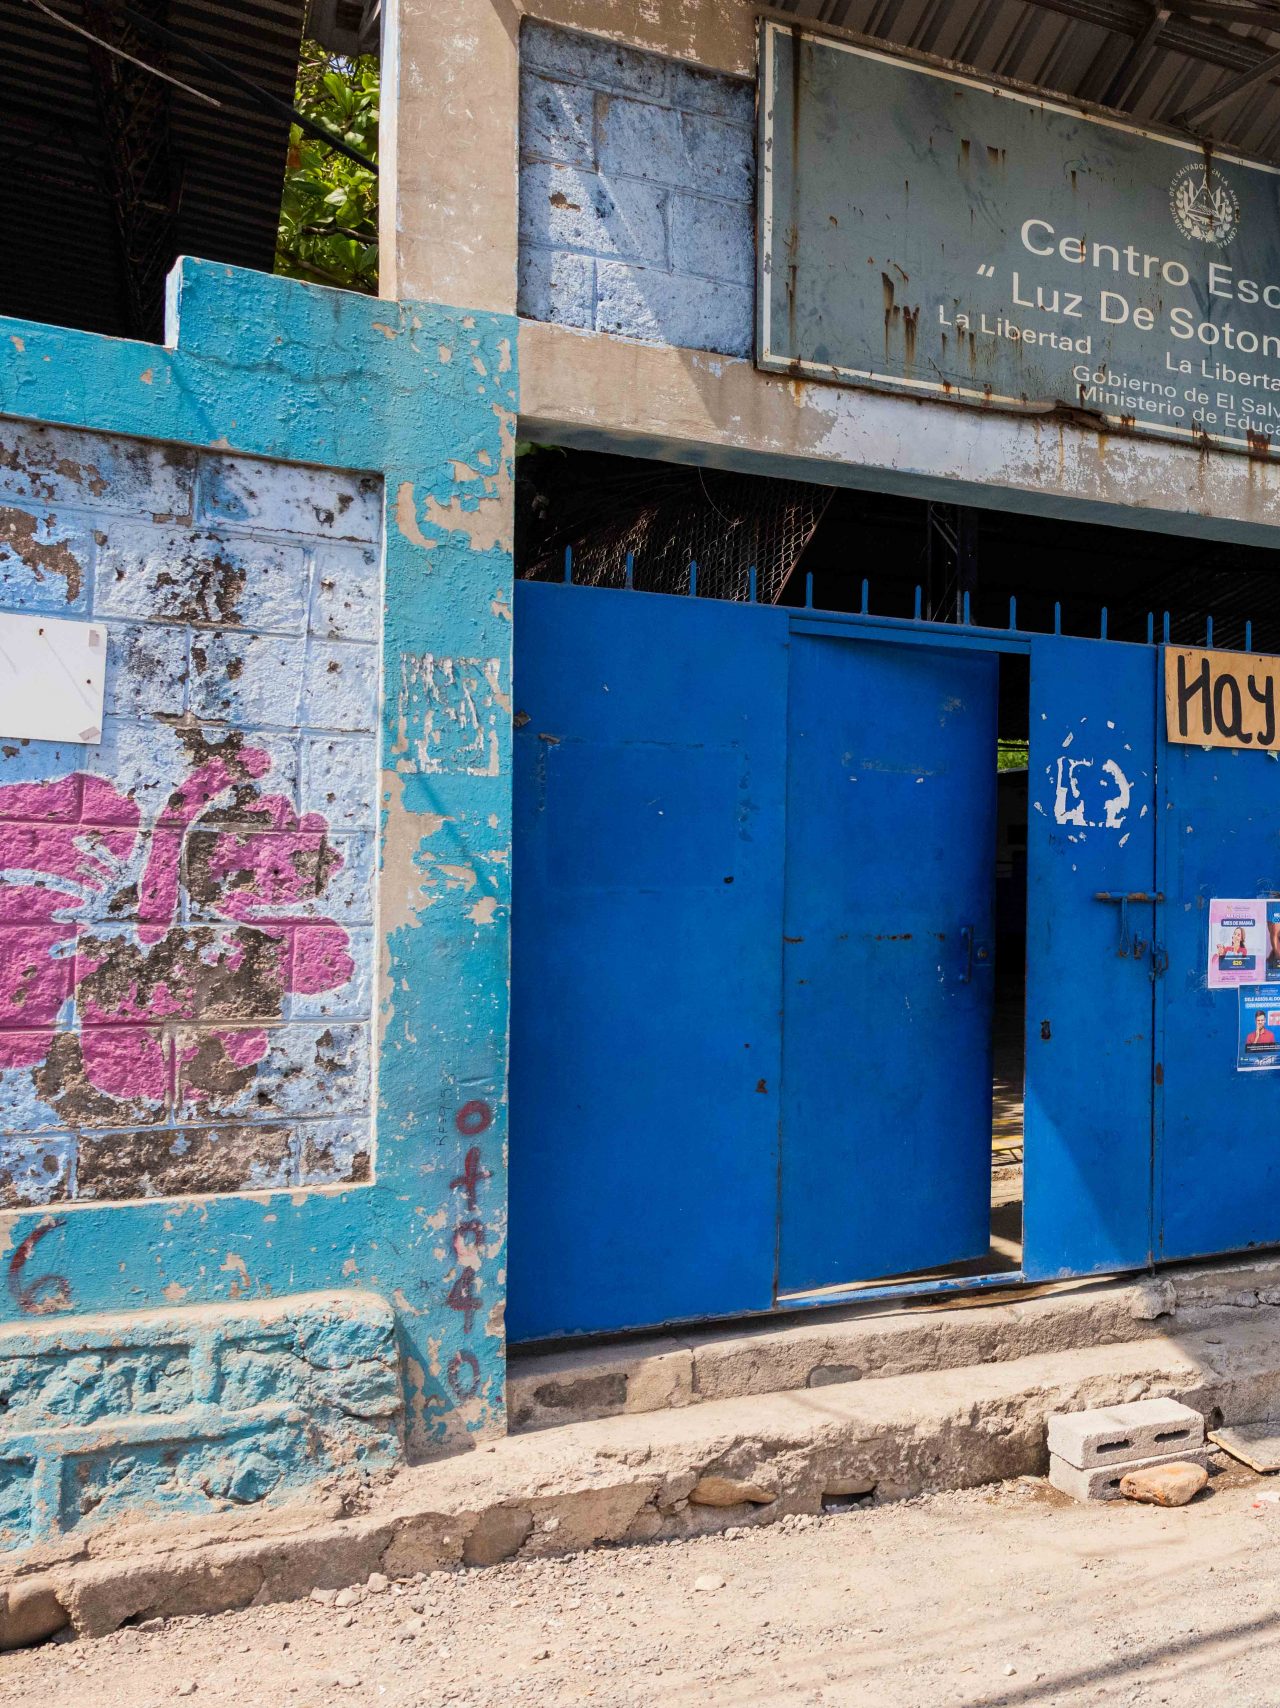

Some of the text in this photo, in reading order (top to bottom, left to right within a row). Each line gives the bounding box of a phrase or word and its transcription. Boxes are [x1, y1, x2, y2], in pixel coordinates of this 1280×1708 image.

[1020, 219, 1190, 287] Centro
[1012, 271, 1084, 318] Luz
[1100, 290, 1155, 331] De
[939, 304, 1092, 355] La Libertad
[1072, 365, 1177, 398] Gobierno
[1184, 387, 1209, 405] de
[1216, 392, 1235, 410] El
[1166, 351, 1192, 375] La
[1075, 383, 1185, 418] Ministerio
[1192, 406, 1218, 424] de
[1176, 654, 1275, 747] Hay
